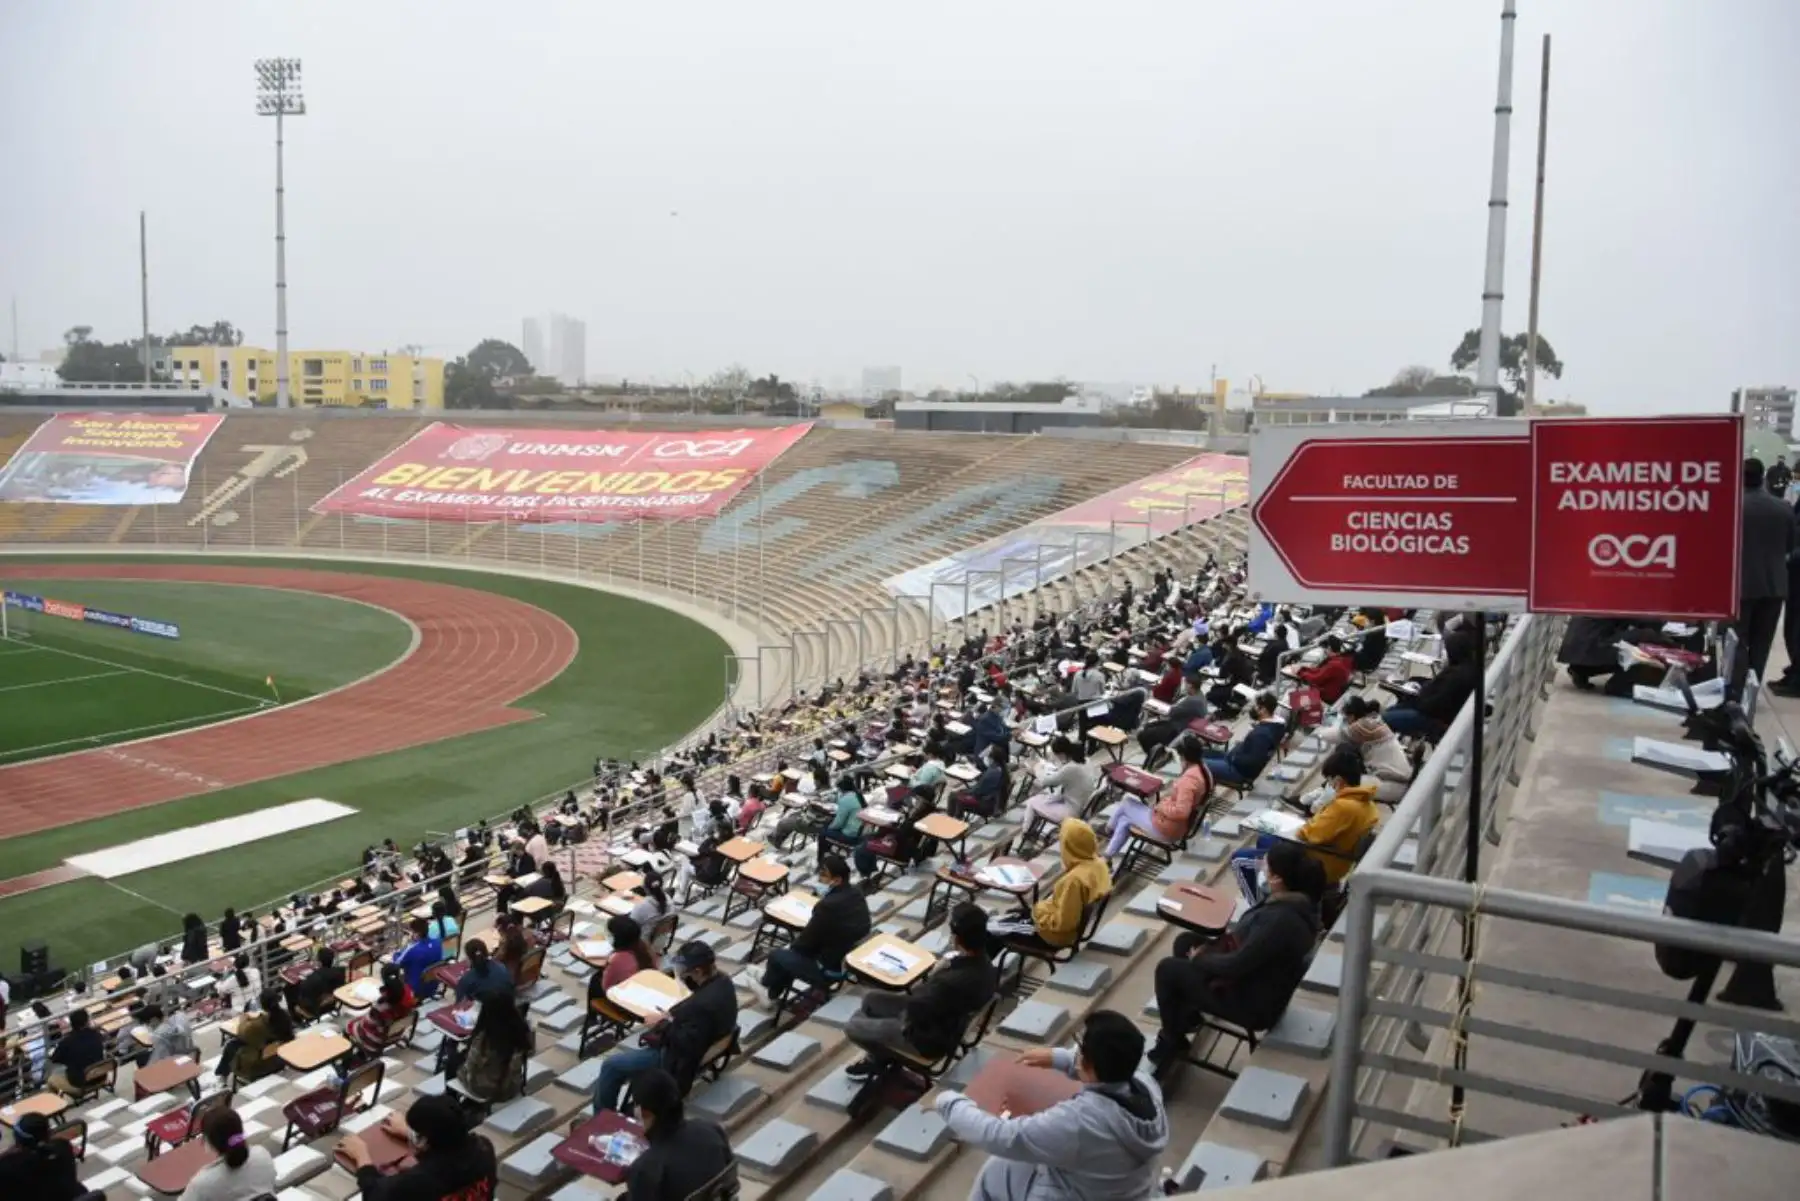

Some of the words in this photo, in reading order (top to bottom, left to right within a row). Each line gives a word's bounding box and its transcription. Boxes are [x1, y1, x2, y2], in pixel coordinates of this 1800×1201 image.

[372, 463, 747, 495] BIENVENIDOS
[1342, 474, 1429, 490] FACULTAD
[1434, 474, 1458, 490] DE
[1549, 462, 1675, 484] EXAMEN
[1679, 462, 1721, 484] DE
[393, 489, 500, 504] EXAMEN
[1557, 485, 1710, 512] ADMISIÓN
[1347, 511, 1453, 532] CIENCIAS
[1330, 529, 1470, 555] BIOLÓGICAS
[1588, 533, 1676, 569] OCA
